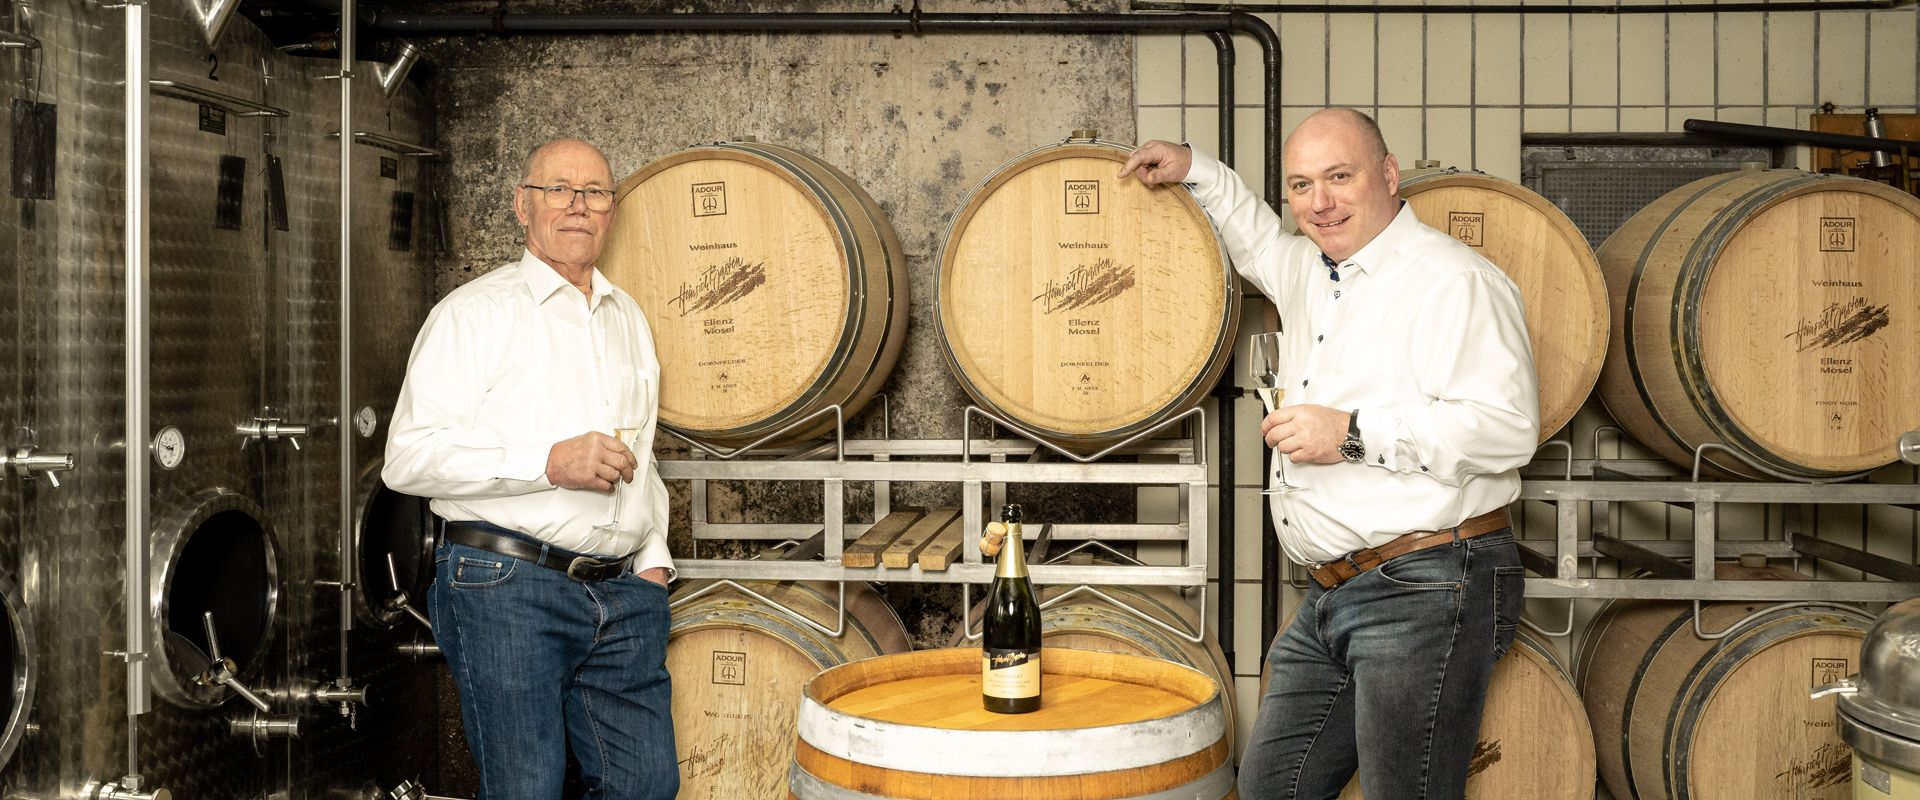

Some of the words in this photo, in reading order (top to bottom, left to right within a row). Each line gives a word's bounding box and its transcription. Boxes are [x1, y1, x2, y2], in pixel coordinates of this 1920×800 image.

[207, 53, 218, 81] 2
[694, 185, 723, 194] ADOUR
[1451, 215, 1481, 223] ADOUR
[689, 241, 738, 251] Weinhaus
[1058, 241, 1109, 249] Weinhaus
[1811, 279, 1864, 288] Weinhaus
[703, 318, 735, 327] Ellenz
[1068, 319, 1100, 327] Ellenz
[703, 326, 735, 335] Mosel
[1068, 327, 1100, 335] Mosel
[1820, 366, 1853, 374] Mosel
[715, 654, 744, 663] ADOUR
